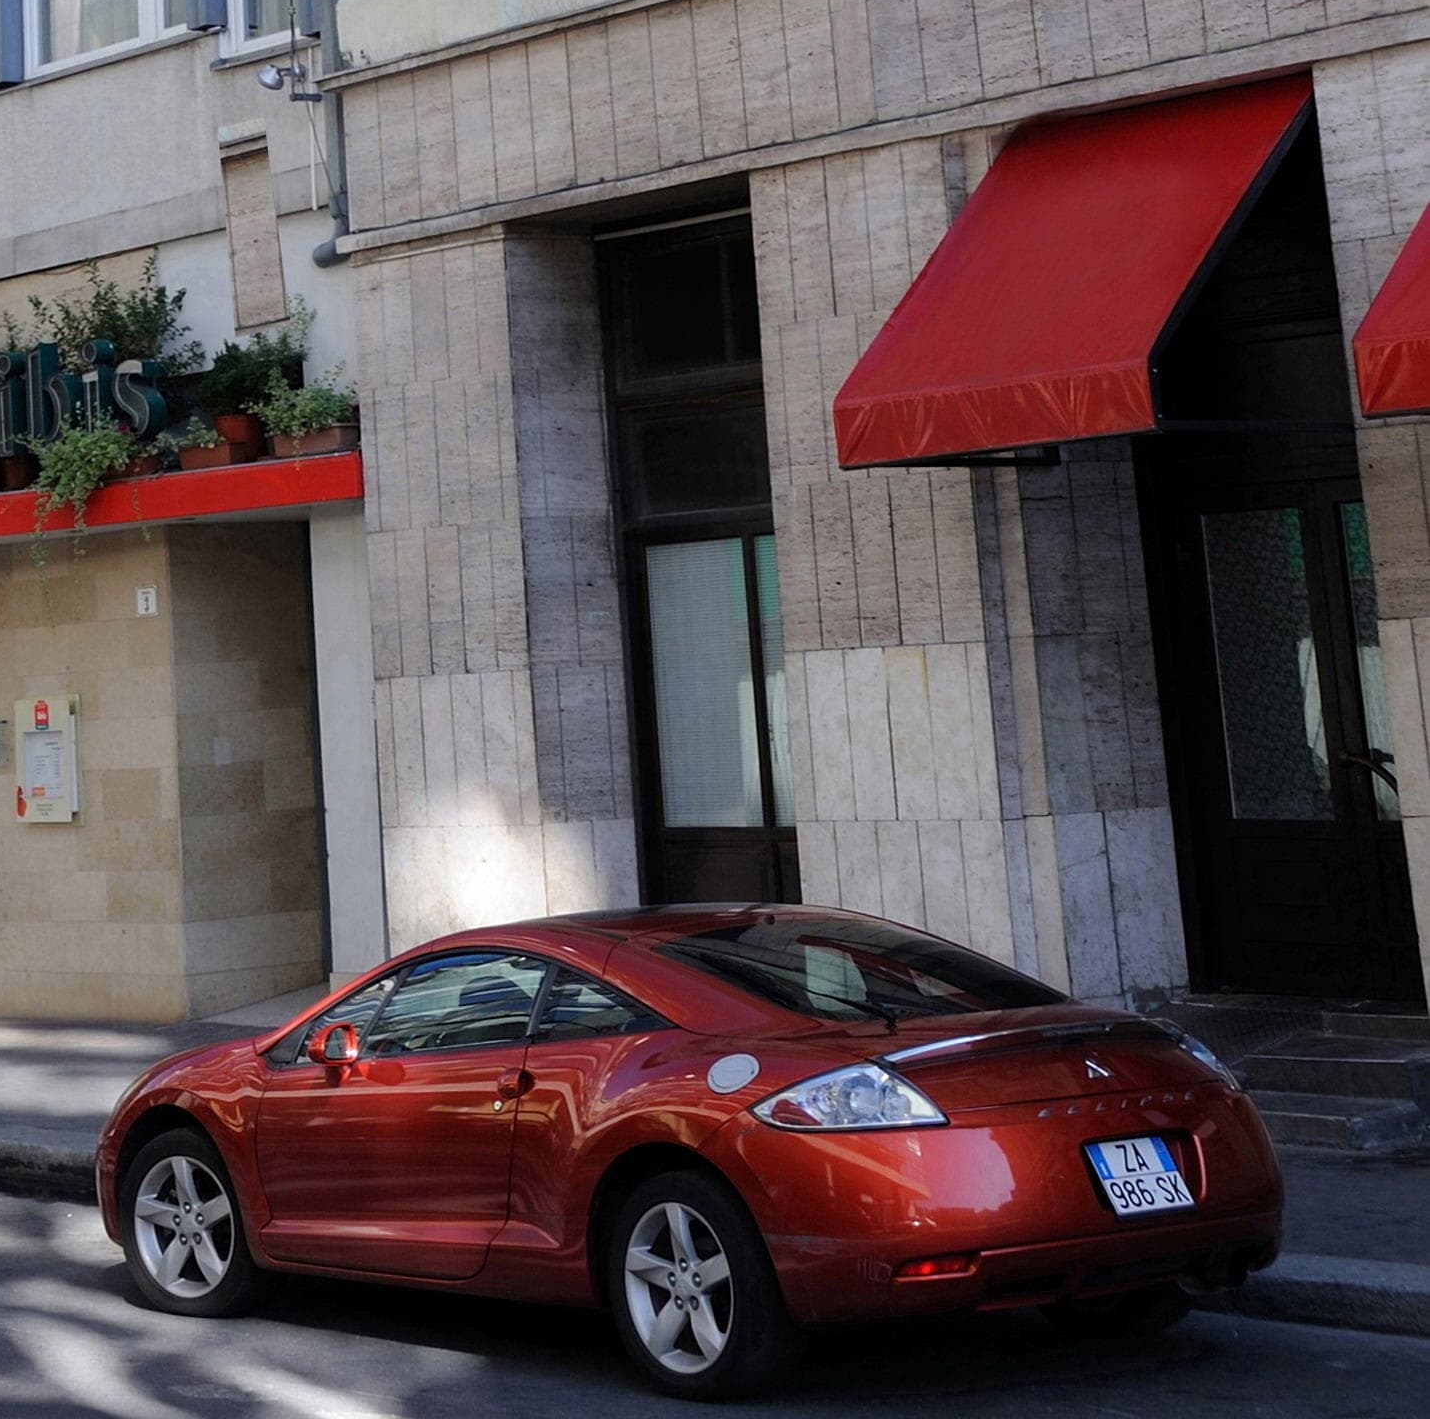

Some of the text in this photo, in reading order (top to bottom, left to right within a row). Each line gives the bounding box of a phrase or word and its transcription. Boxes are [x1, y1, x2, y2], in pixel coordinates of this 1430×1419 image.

[1115, 1143, 1150, 1173] ZA
[1110, 1174, 1190, 1209] 986 SK
